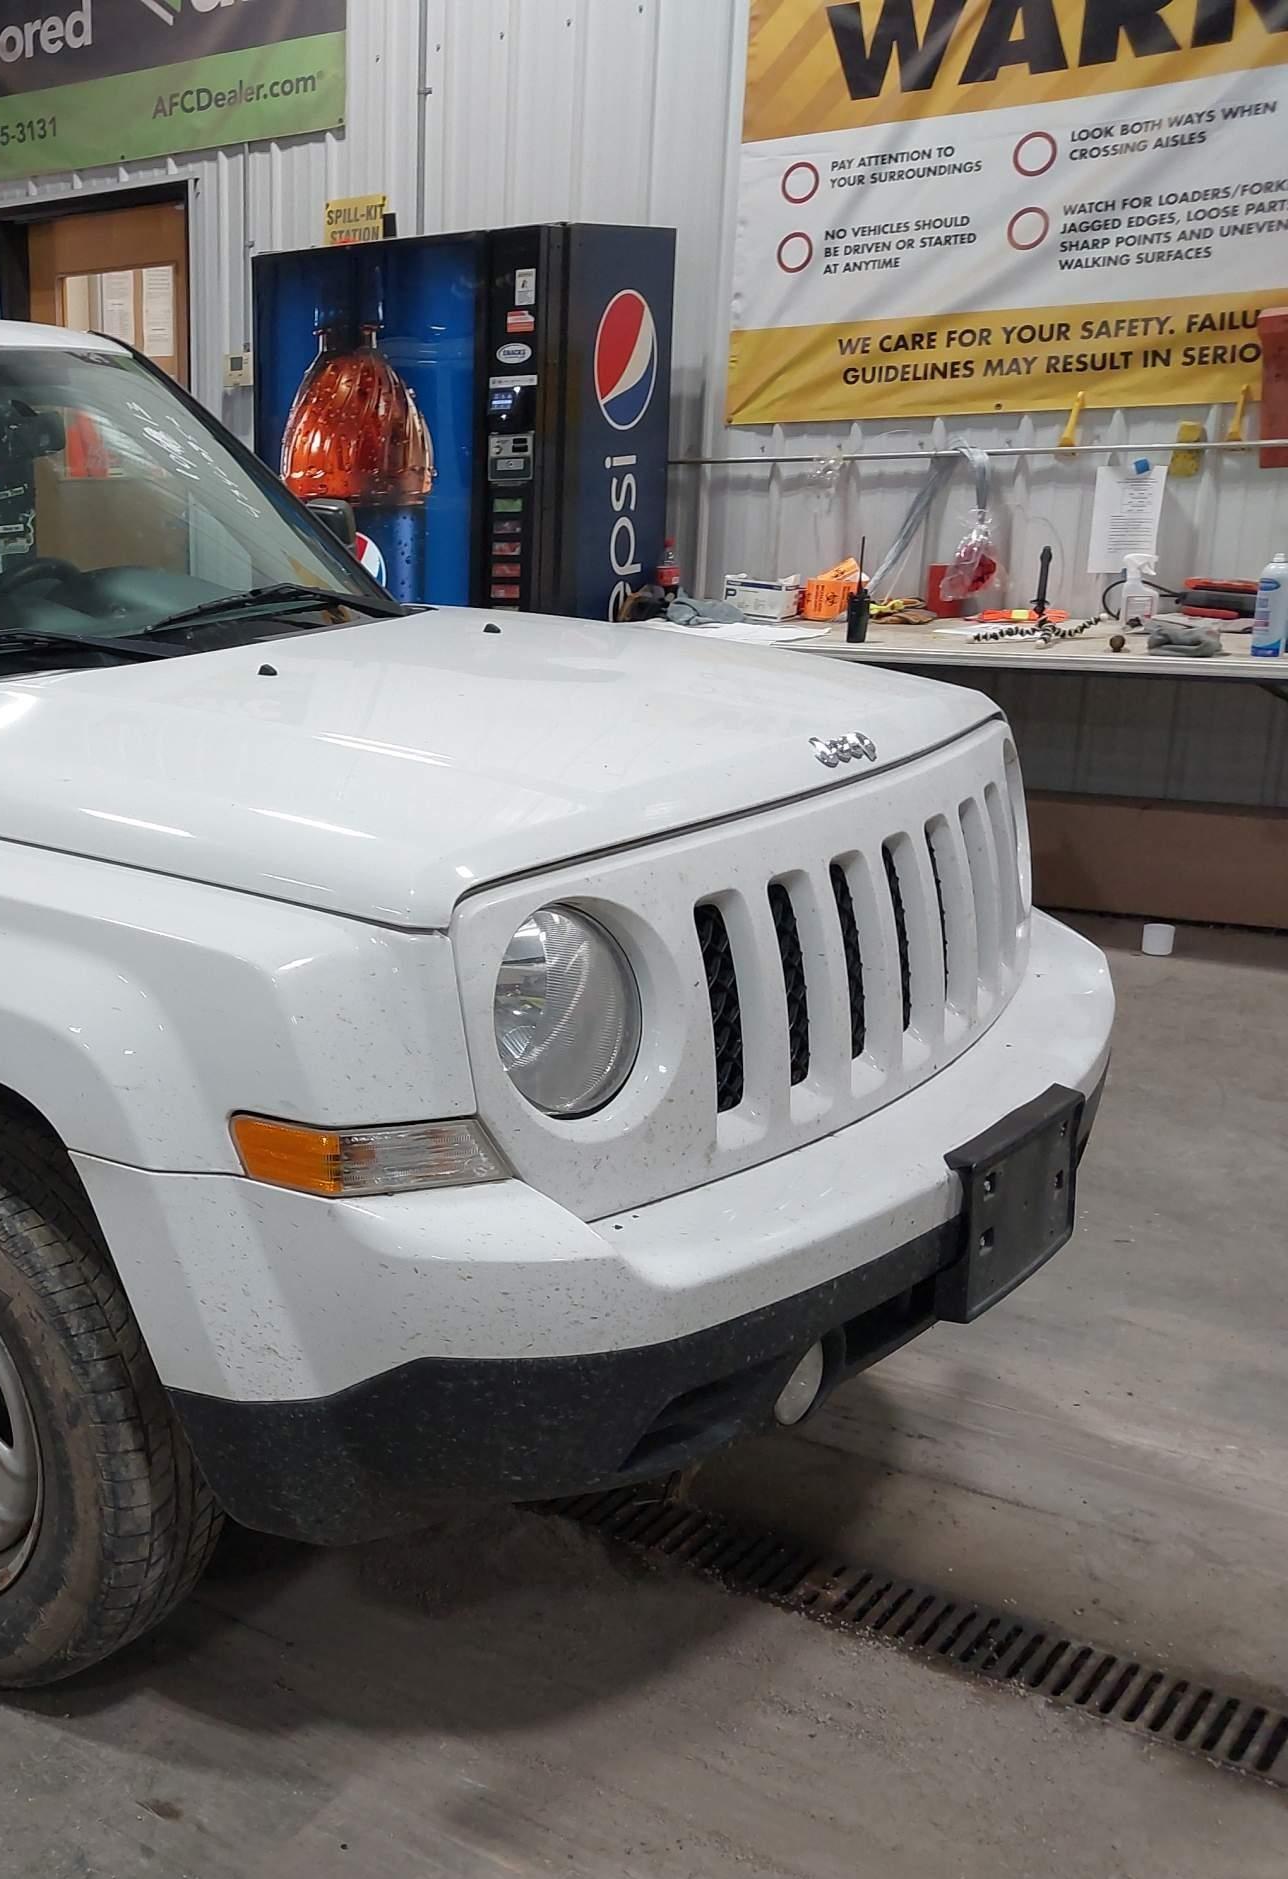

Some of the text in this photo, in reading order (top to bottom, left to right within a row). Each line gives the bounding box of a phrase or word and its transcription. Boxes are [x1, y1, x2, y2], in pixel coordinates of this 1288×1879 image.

[1071, 101, 1278, 142] LOOK BOTH WAYS WHEN
[831, 145, 955, 172] PAY ATTENTION TO
[1069, 131, 1207, 161] CROSSING AISLES
[830, 160, 982, 189] YOUR SURROUNDINGS
[1063, 178, 1288, 216] WATCH FOR LOADERS/FORK
[326, 204, 385, 225] SPILL-KIT
[824, 215, 970, 240] NO VEHICLES SHOULD
[1060, 199, 1288, 234] JAGGED EDGES, LOOSE PART
[330, 226, 380, 243] STATION
[824, 232, 977, 257] BE DRIVEN OR STARTED
[1059, 219, 1288, 252] SHARP POINTS AND UNEVEN
[823, 257, 901, 275] AT ANYTIME
[1058, 246, 1212, 270] WALKING SURFACES
[838, 336, 872, 356] WE
[879, 331, 937, 353] CARE
[946, 328, 992, 348] FOR
[1002, 322, 1071, 345] YOUR
[1080, 315, 1175, 340] SAFETY.
[843, 359, 975, 385] GUIDELINES
[983, 356, 1039, 377] MAY
[1046, 351, 1133, 373] RESULT
[1142, 347, 1173, 368] IN
[808, 732, 877, 768] Jeep
